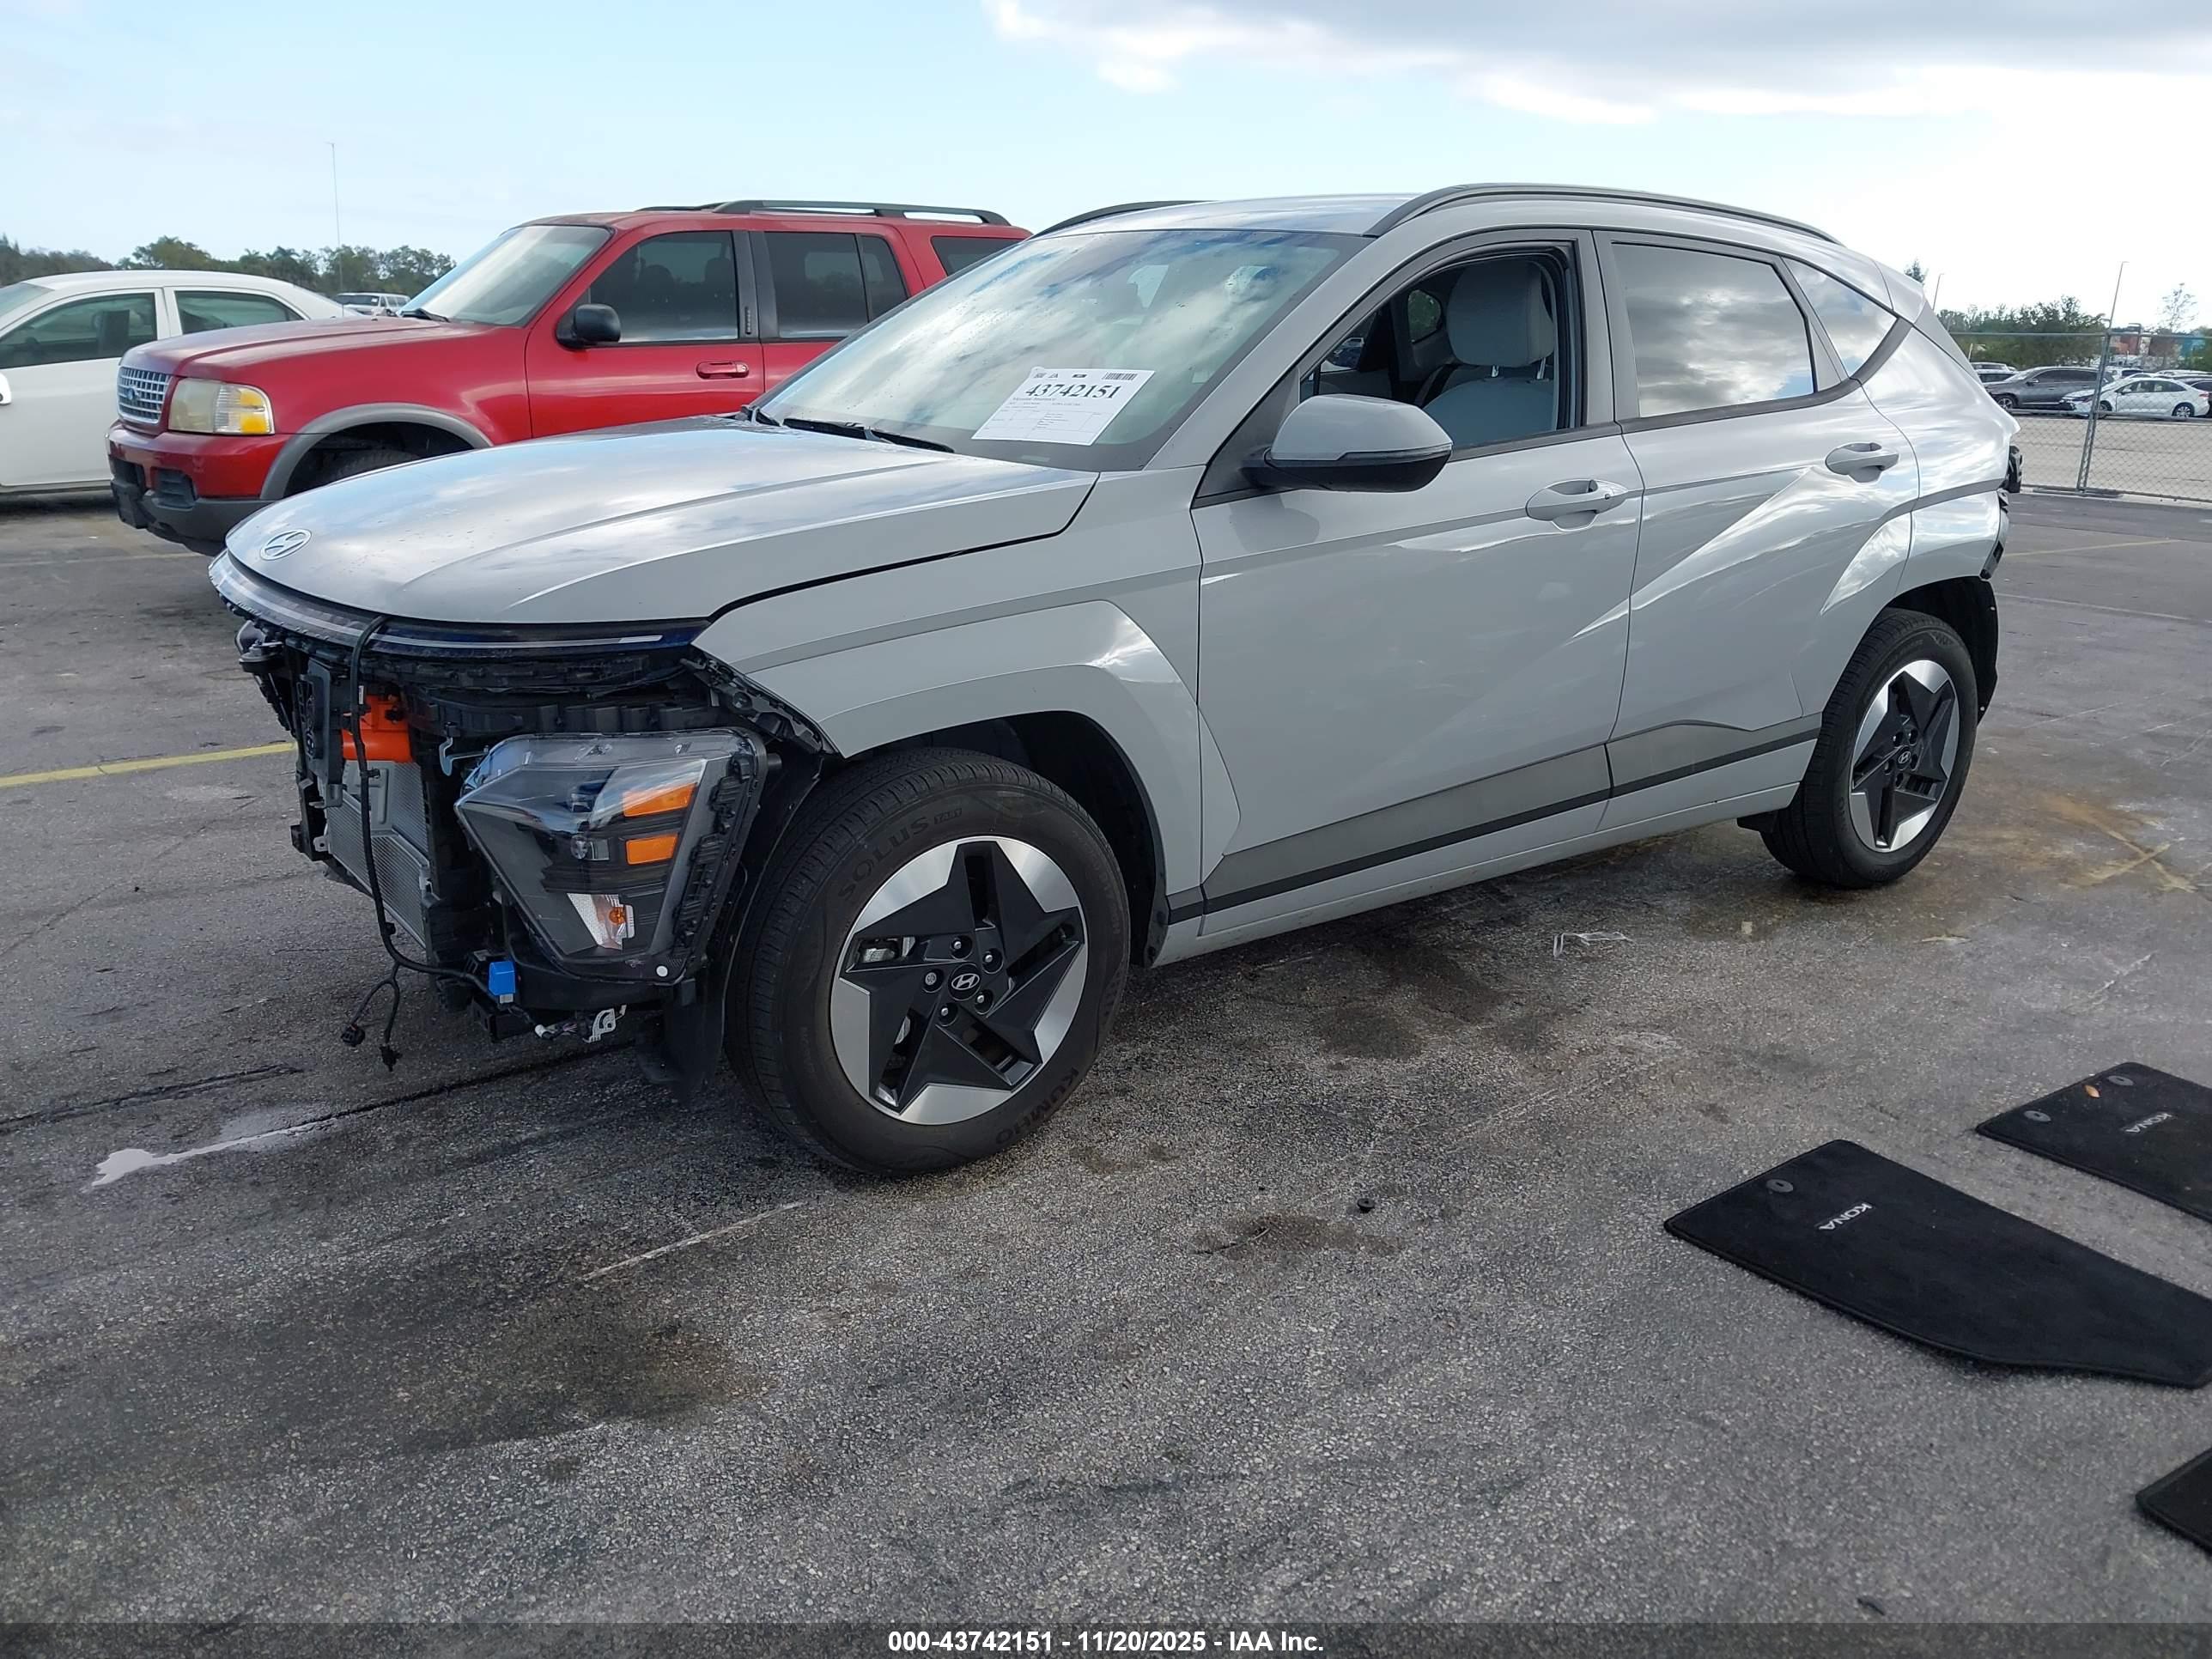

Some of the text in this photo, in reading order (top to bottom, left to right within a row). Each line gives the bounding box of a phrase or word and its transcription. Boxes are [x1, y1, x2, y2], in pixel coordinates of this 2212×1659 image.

[1025, 383, 1121, 399] 43742151
[838, 816, 930, 901] SOLUS
[996, 1066, 1080, 1145] KUMHO
[2125, 1112, 2172, 1133] KONA
[1818, 1202, 1873, 1231] KONA
